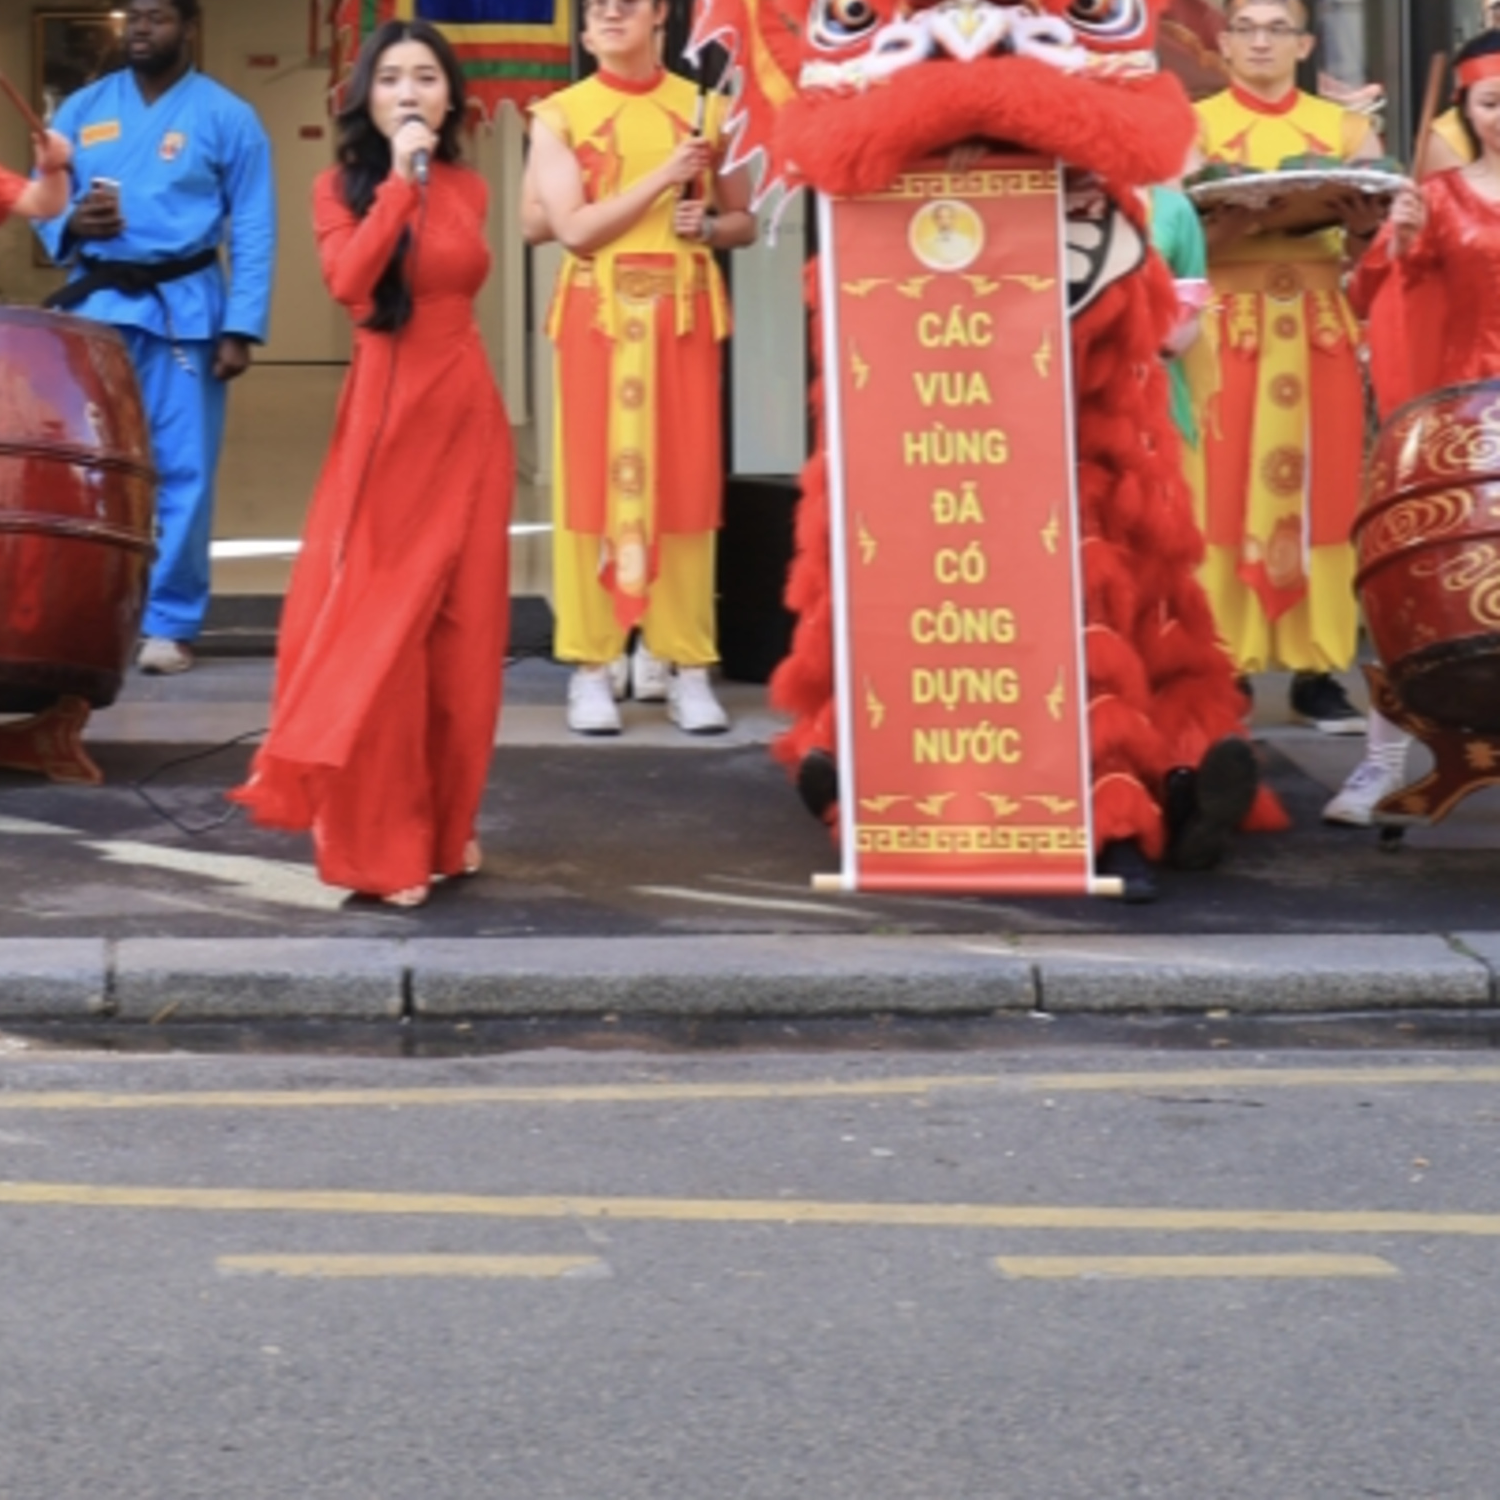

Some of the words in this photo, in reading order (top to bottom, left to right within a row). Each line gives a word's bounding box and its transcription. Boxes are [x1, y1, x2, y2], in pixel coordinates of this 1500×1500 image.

[917, 304, 993, 348] CÁC
[912, 372, 992, 406] VUA
[903, 421, 1008, 465] HÙNG
[931, 480, 985, 524] ĐÃ
[933, 540, 987, 584] CÓ
[911, 599, 1016, 644] CÔNG
[911, 667, 1020, 712] DỰNG
[913, 719, 1022, 764] NƯỚC
